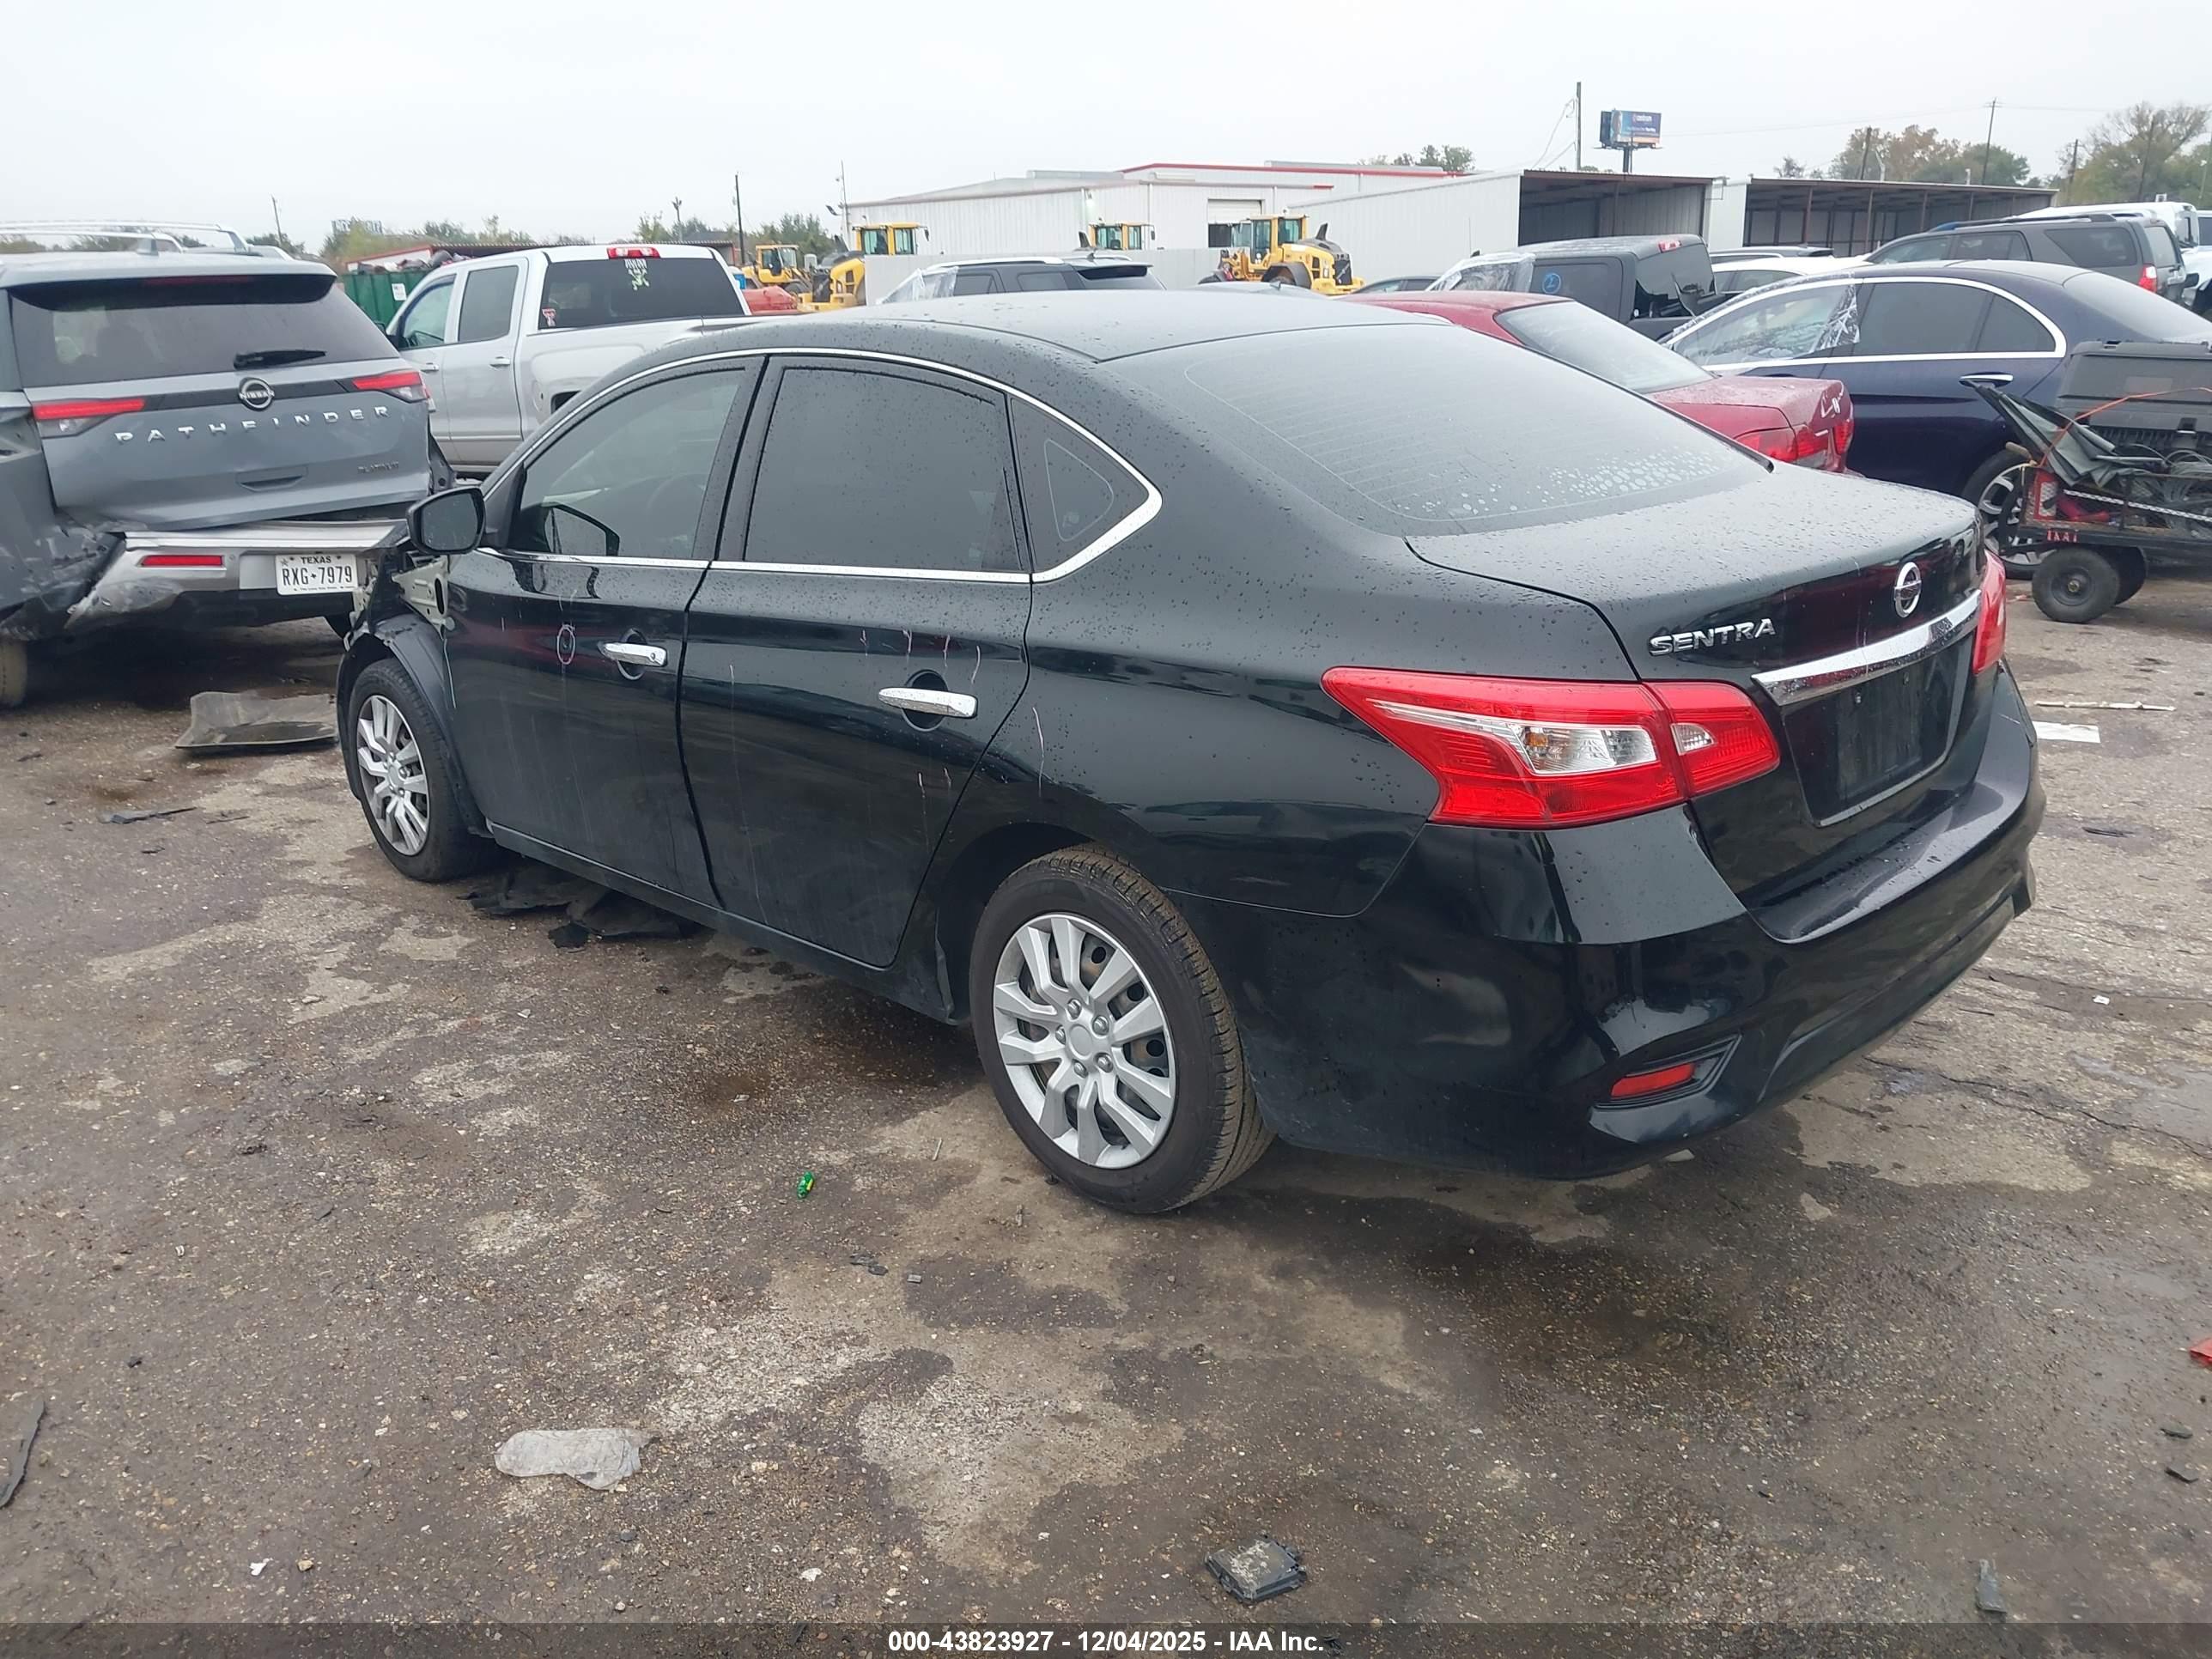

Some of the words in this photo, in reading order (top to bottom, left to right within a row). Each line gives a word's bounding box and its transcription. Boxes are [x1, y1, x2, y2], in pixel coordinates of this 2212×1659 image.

[114, 405, 390, 443] PATHFINDER
[301, 556, 331, 564] TEXAS
[1649, 617, 1776, 656] SENTRA
